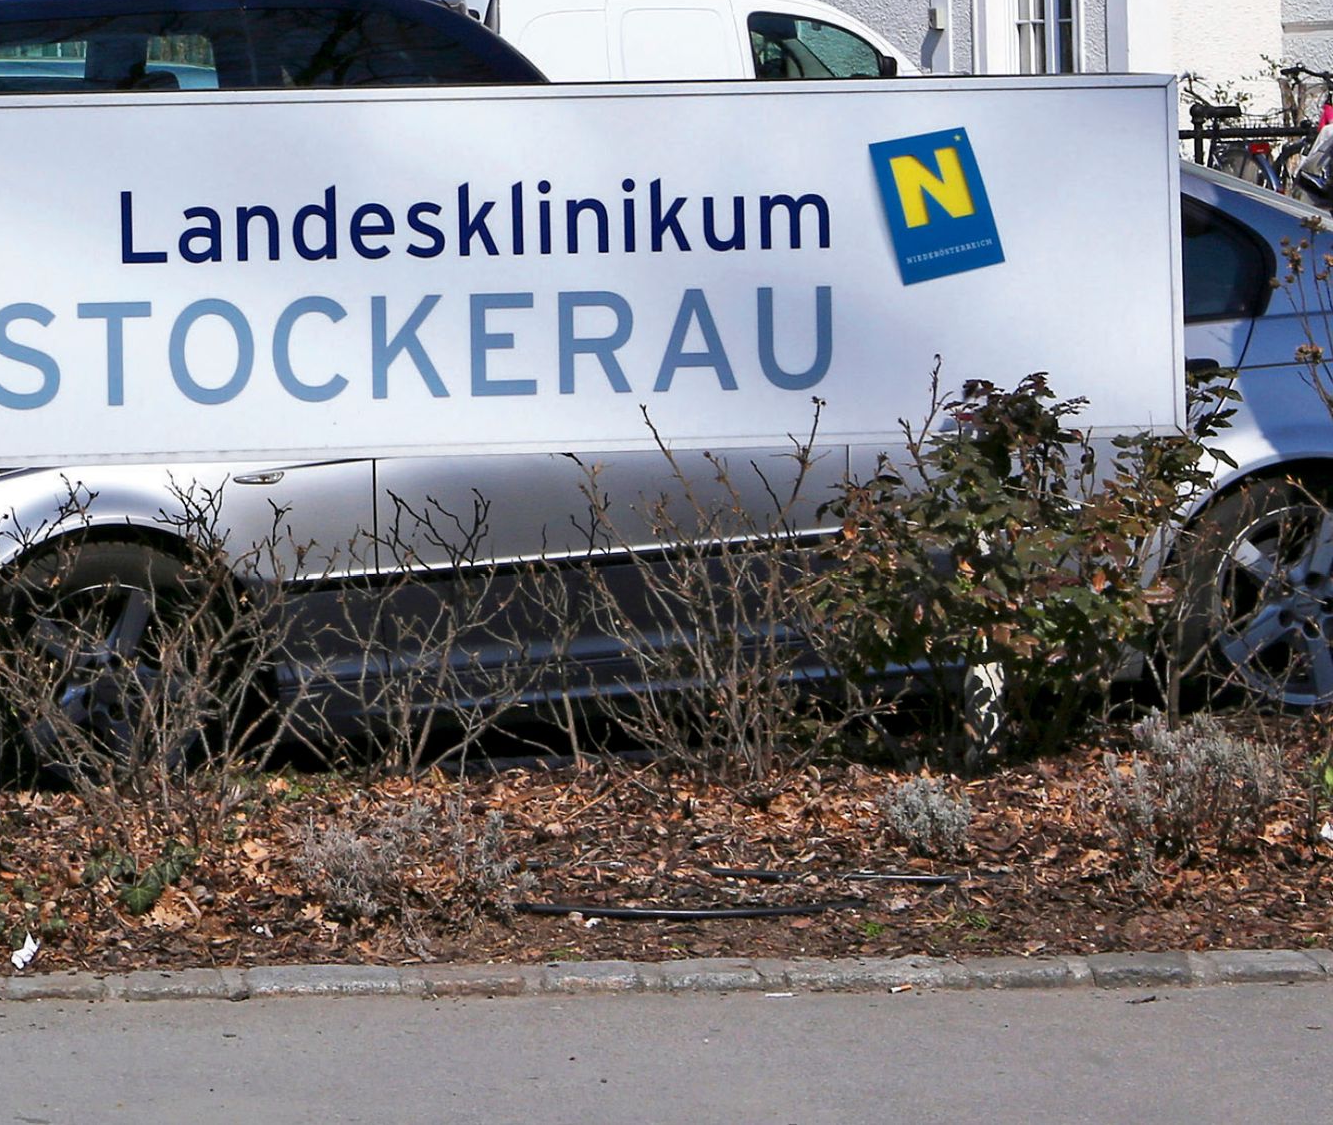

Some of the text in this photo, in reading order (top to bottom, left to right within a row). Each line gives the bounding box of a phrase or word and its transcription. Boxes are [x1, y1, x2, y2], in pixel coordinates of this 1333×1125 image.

[120, 177, 832, 264] Landesklinikum
[888, 146, 975, 229] N
[906, 238, 993, 264] NIEDERÖSTERREICH
